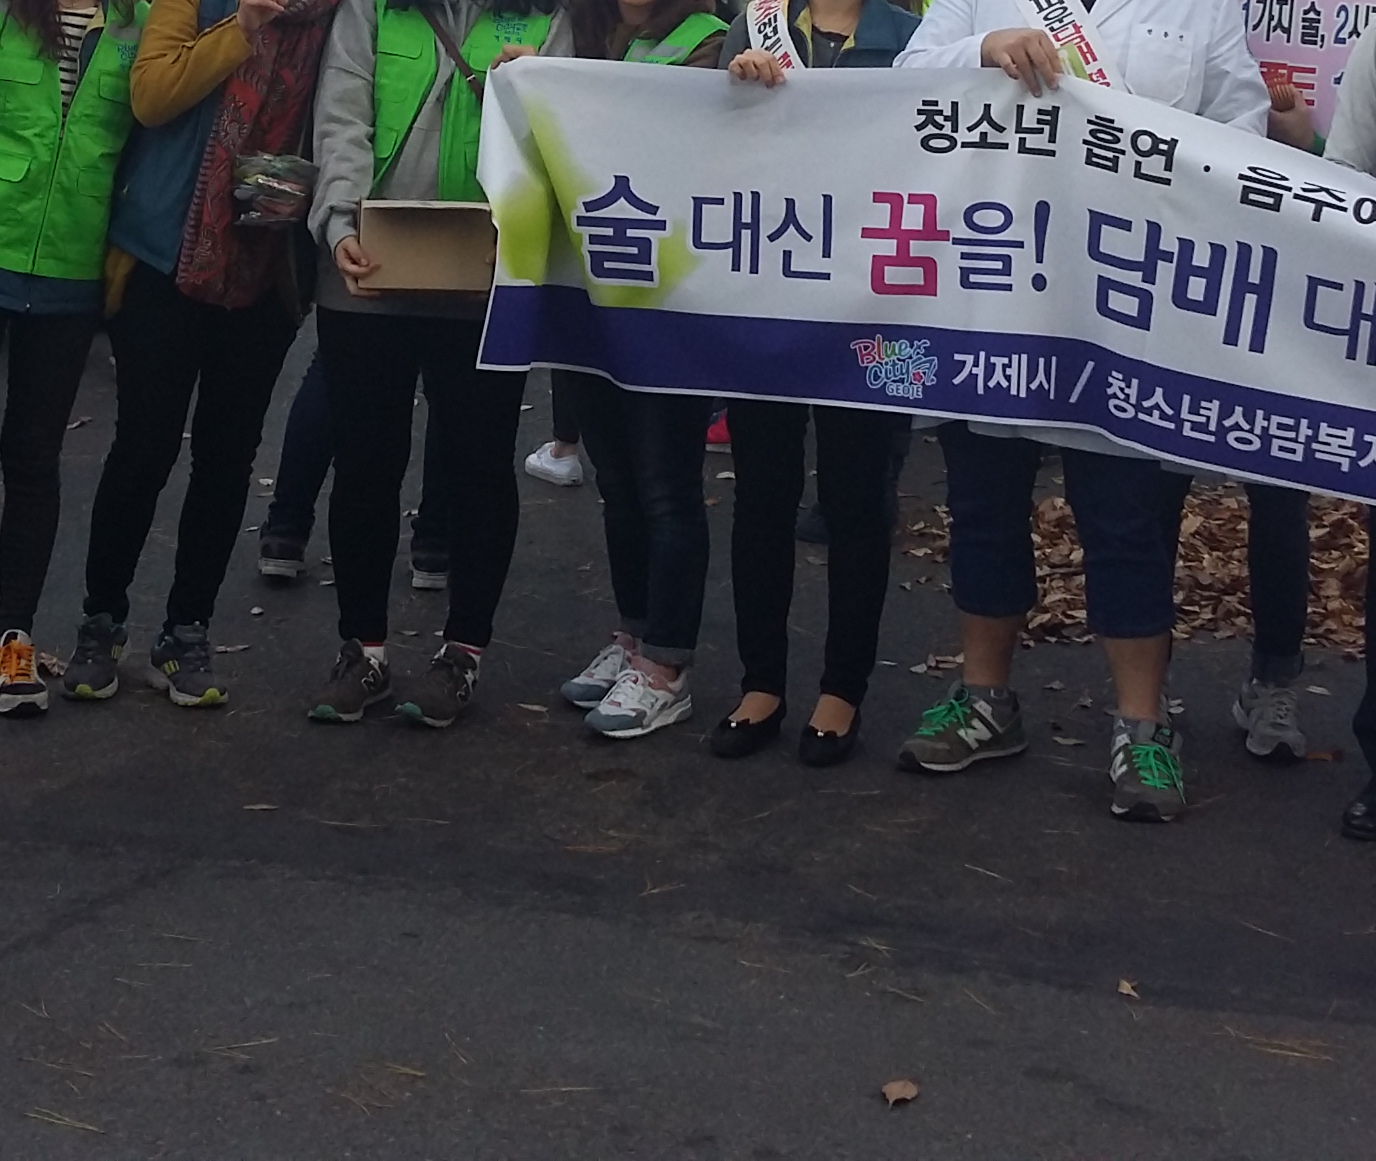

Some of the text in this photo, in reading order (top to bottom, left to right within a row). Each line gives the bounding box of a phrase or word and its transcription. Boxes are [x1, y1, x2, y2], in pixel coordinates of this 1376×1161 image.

[1300, 0, 1326, 49] 술,
[914, 99, 1060, 158] 청소년
[1082, 114, 1179, 186] 흡연
[575, 175, 668, 283] 술
[691, 191, 834, 281] 대신
[860, 191, 1050, 296] 꿈을!
[1086, 207, 1280, 354] 담배
[850, 334, 911, 366] Blue
[866, 358, 911, 388] City
[886, 382, 923, 399] GEOJE
[952, 349, 1057, 401] 거제시
